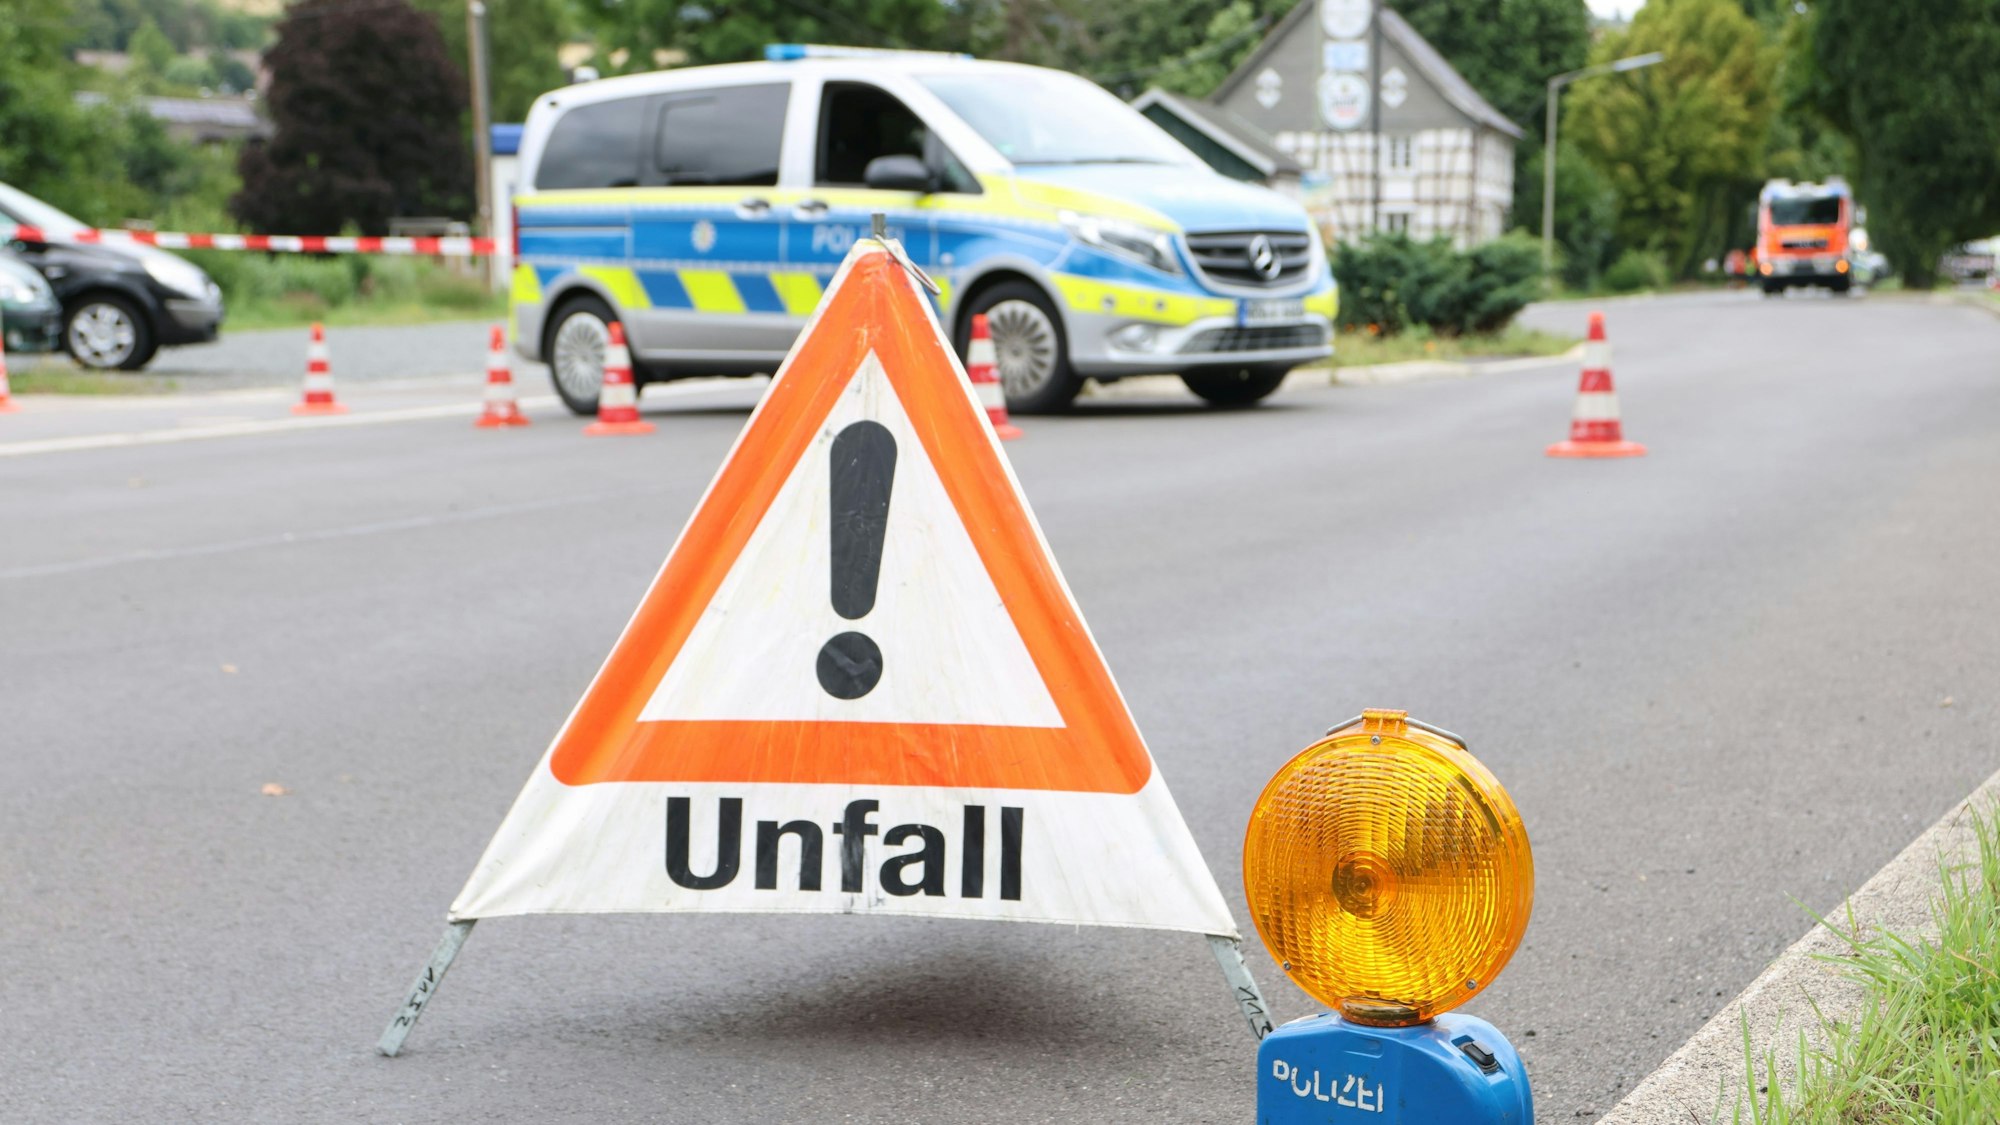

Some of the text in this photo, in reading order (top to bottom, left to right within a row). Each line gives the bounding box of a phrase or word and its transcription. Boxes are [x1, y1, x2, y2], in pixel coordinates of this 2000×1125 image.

[812, 225, 906, 254] POLI
[665, 796, 1024, 901] Unfall
[1272, 1059, 1384, 1113] POLIZEI
